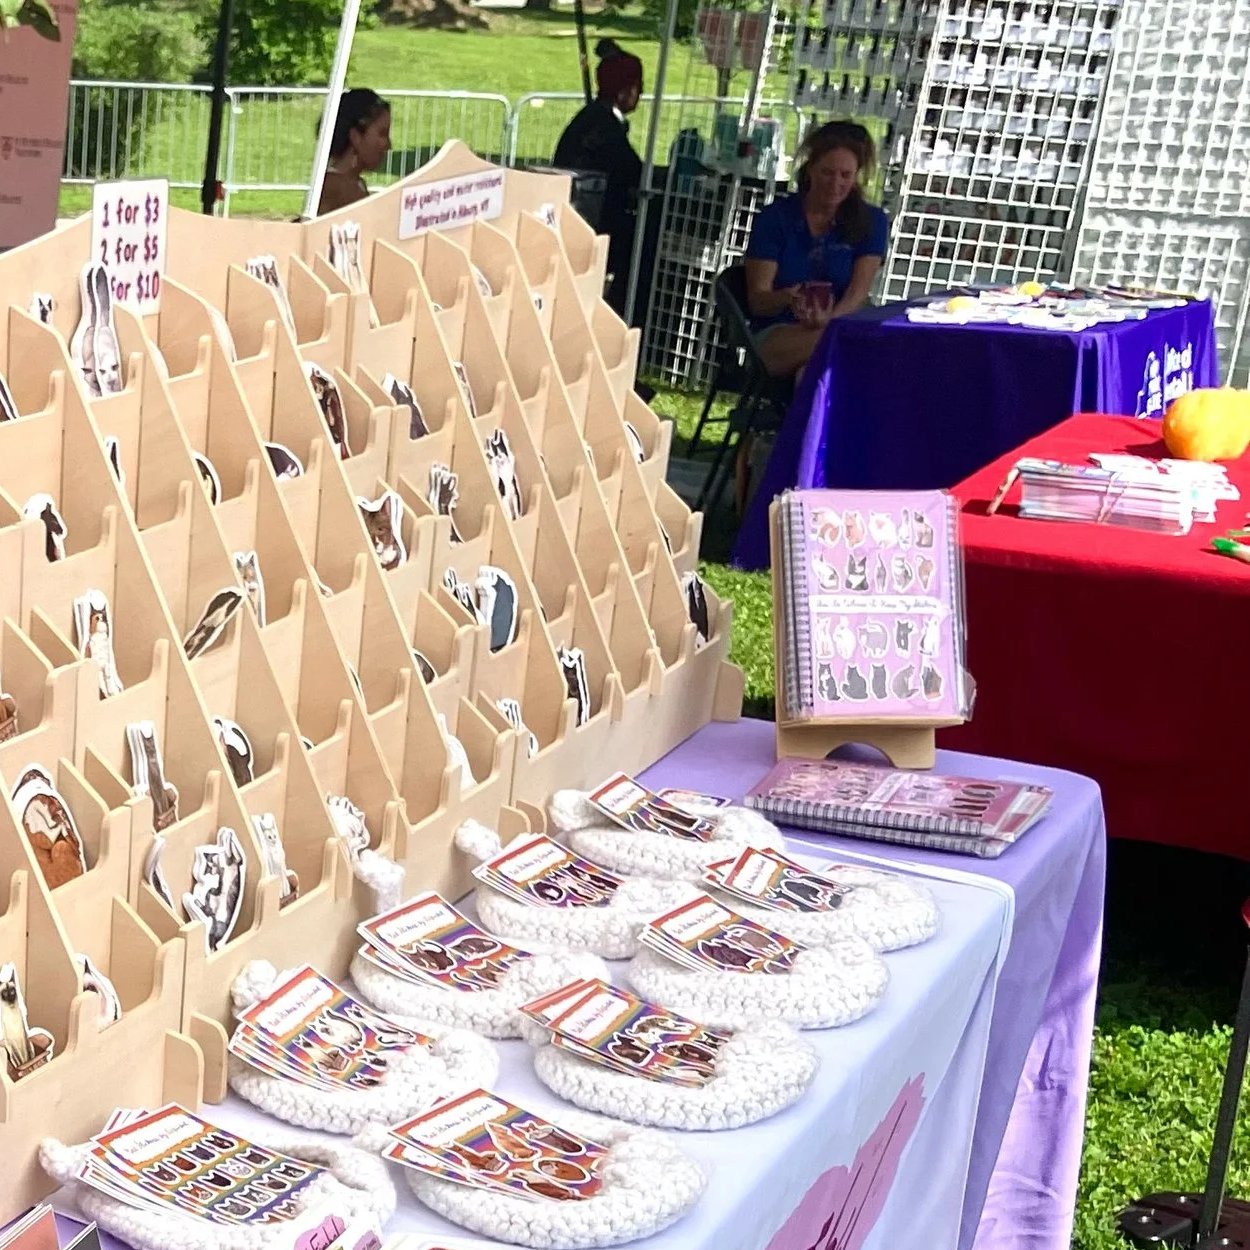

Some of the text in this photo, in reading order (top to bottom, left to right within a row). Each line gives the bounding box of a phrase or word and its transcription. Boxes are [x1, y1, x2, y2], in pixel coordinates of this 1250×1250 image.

[102, 192, 159, 228] 1 for $3
[101, 232, 158, 266] 2 for $5
[137, 270, 159, 304] $10
